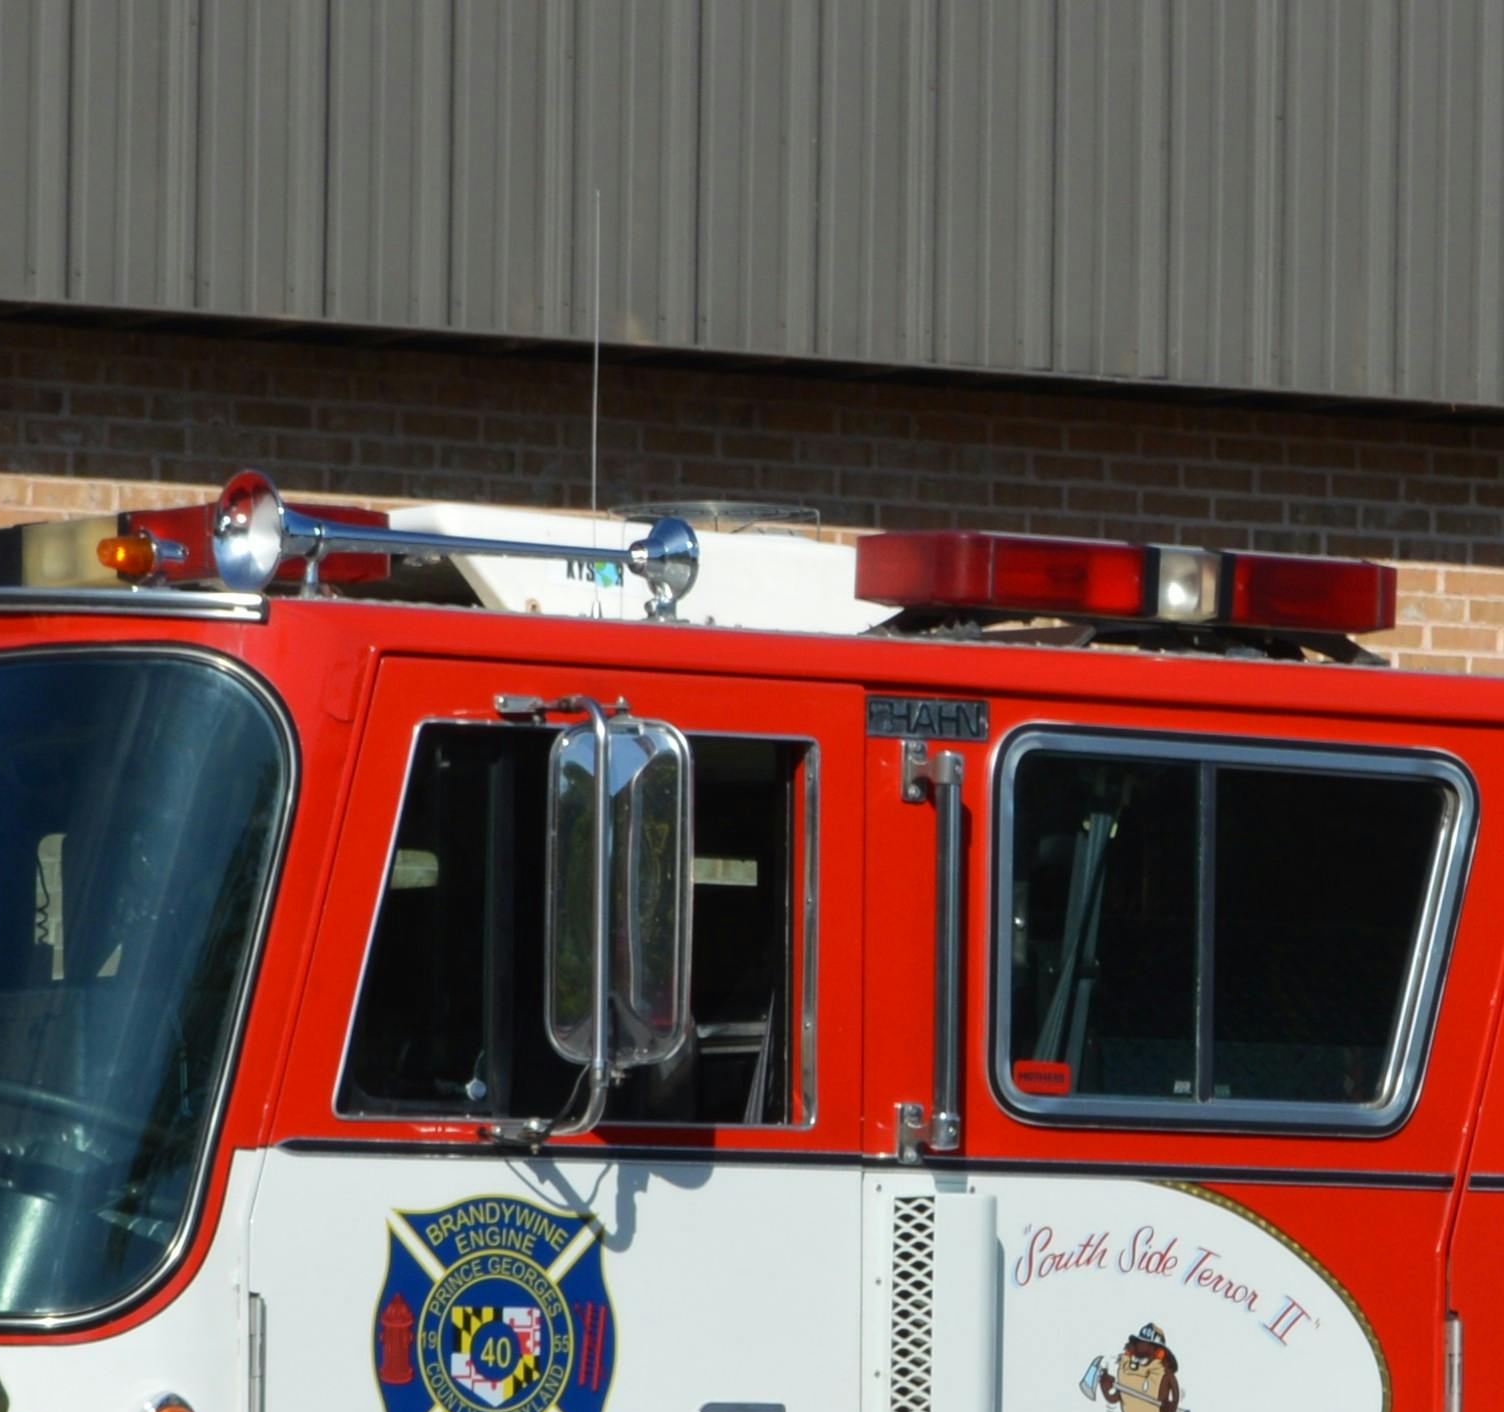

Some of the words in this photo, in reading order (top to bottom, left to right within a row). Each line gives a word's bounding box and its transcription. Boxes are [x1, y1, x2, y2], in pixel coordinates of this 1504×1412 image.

[891, 701, 981, 737] HAHN
[425, 1202, 570, 1251] BRANDYWINE
[455, 1229, 538, 1256] ENGINE
[429, 1258, 484, 1317] PRINCE
[488, 1256, 562, 1318] GEORGES
[1118, 1226, 1179, 1278] Side
[1183, 1245, 1259, 1313] Terror
[480, 1337, 511, 1368] 40
